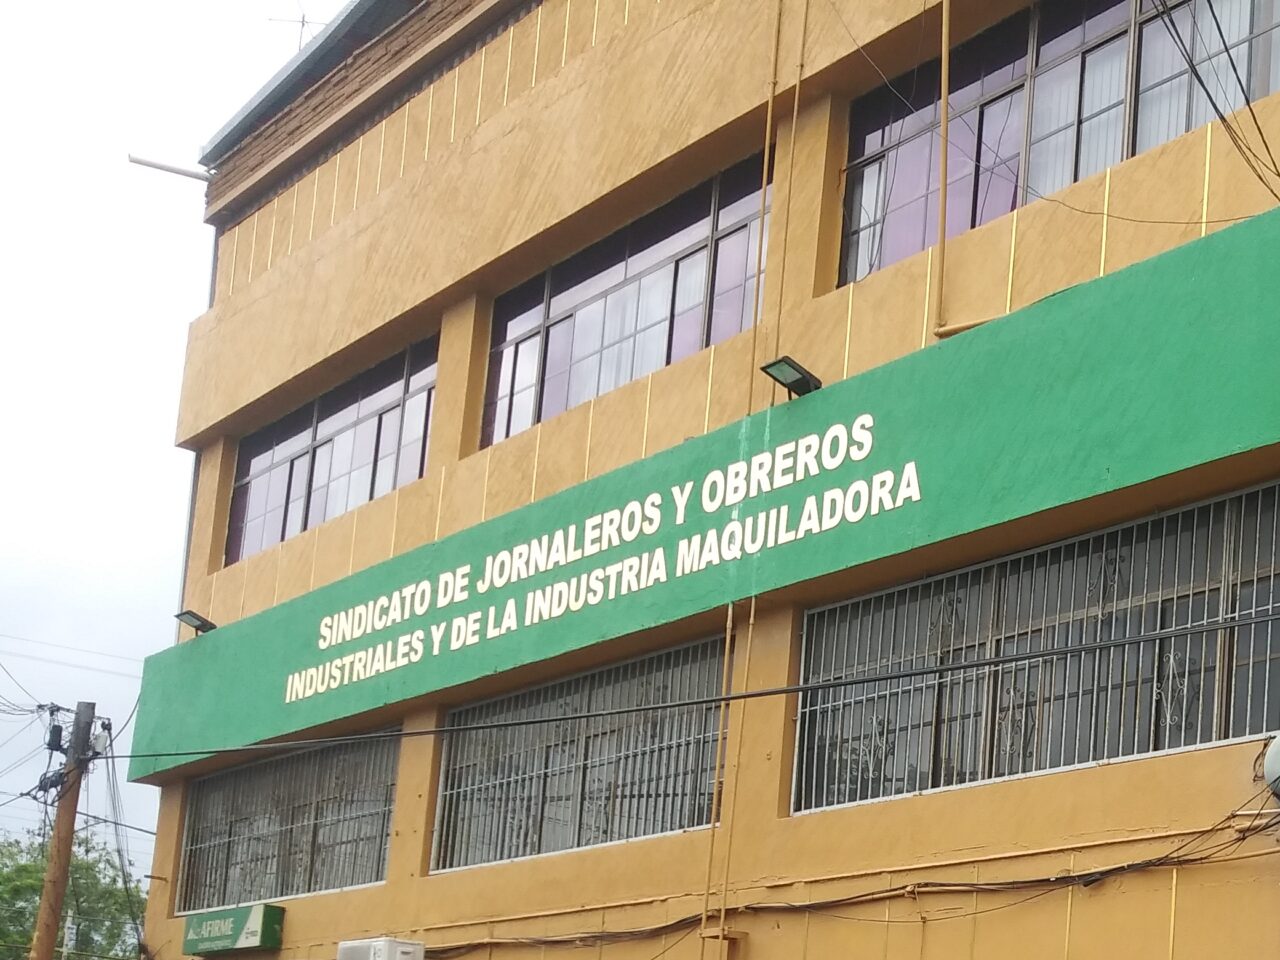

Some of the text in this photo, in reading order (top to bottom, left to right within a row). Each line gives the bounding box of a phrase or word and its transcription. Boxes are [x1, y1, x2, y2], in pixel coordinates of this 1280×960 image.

[285, 461, 921, 703] INDUSTRIALES Y DE LA INDUSTRIA MAQUILADORA
[318, 413, 874, 650] SINDICATO DE JORNALEROS Y OBREROS
[200, 918, 234, 938] AFIRME
